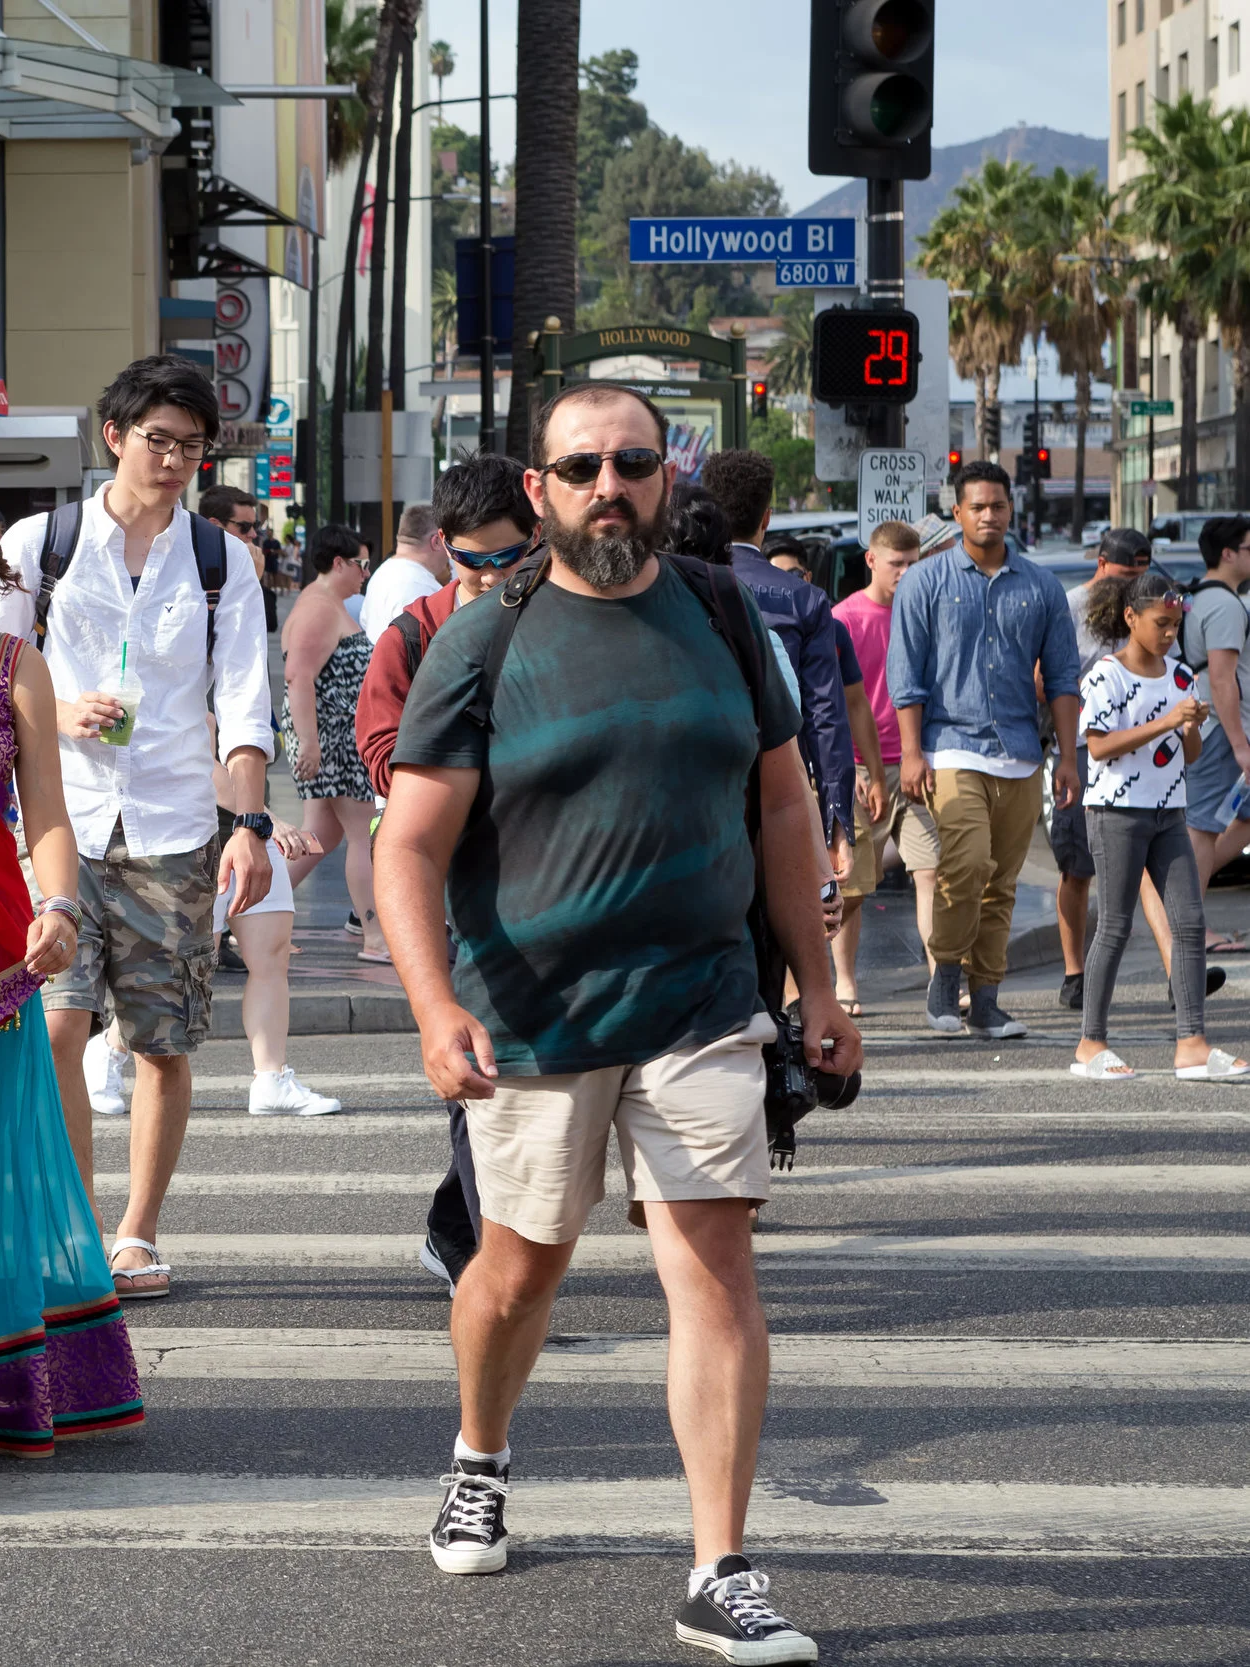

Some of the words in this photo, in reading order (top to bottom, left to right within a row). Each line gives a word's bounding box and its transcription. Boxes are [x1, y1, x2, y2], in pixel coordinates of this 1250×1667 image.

[649, 225, 792, 261] Hollywood
[807, 225, 834, 252] Bl
[780, 263, 828, 283] 6800
[834, 263, 848, 283] W
[600, 328, 691, 348] HOLLYWOOD
[864, 330, 908, 385] 29
[870, 455, 916, 471] CROSS
[885, 474, 901, 487] ON
[874, 489, 910, 505] WALK
[867, 507, 915, 524] SIGNAL
